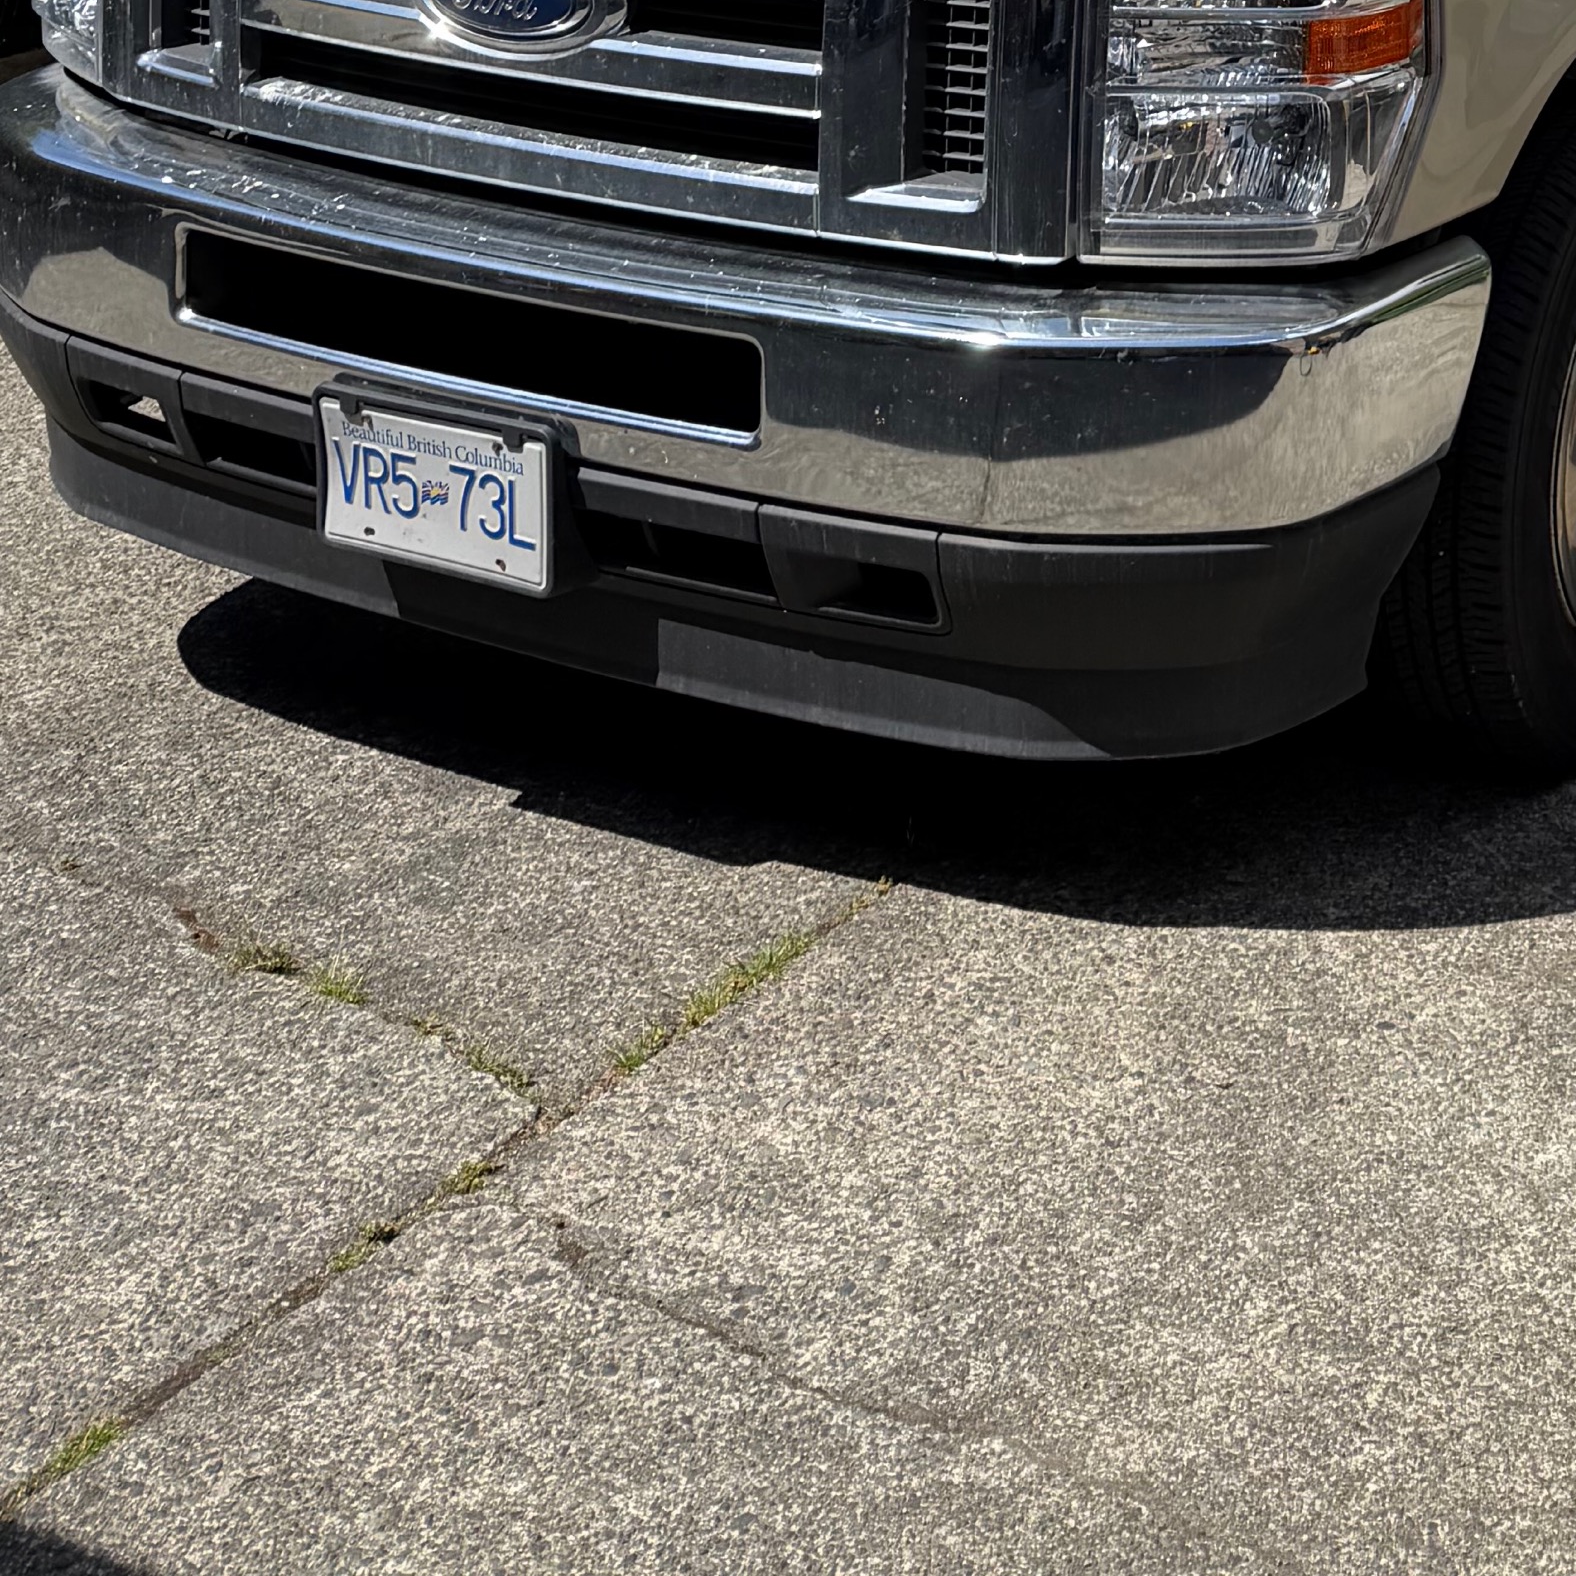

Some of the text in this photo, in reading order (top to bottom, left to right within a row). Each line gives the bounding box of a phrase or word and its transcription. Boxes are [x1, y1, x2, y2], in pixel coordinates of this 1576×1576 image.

[342, 420, 524, 476] Beautiful British Columbia
[332, 437, 537, 552] VR5 73L
